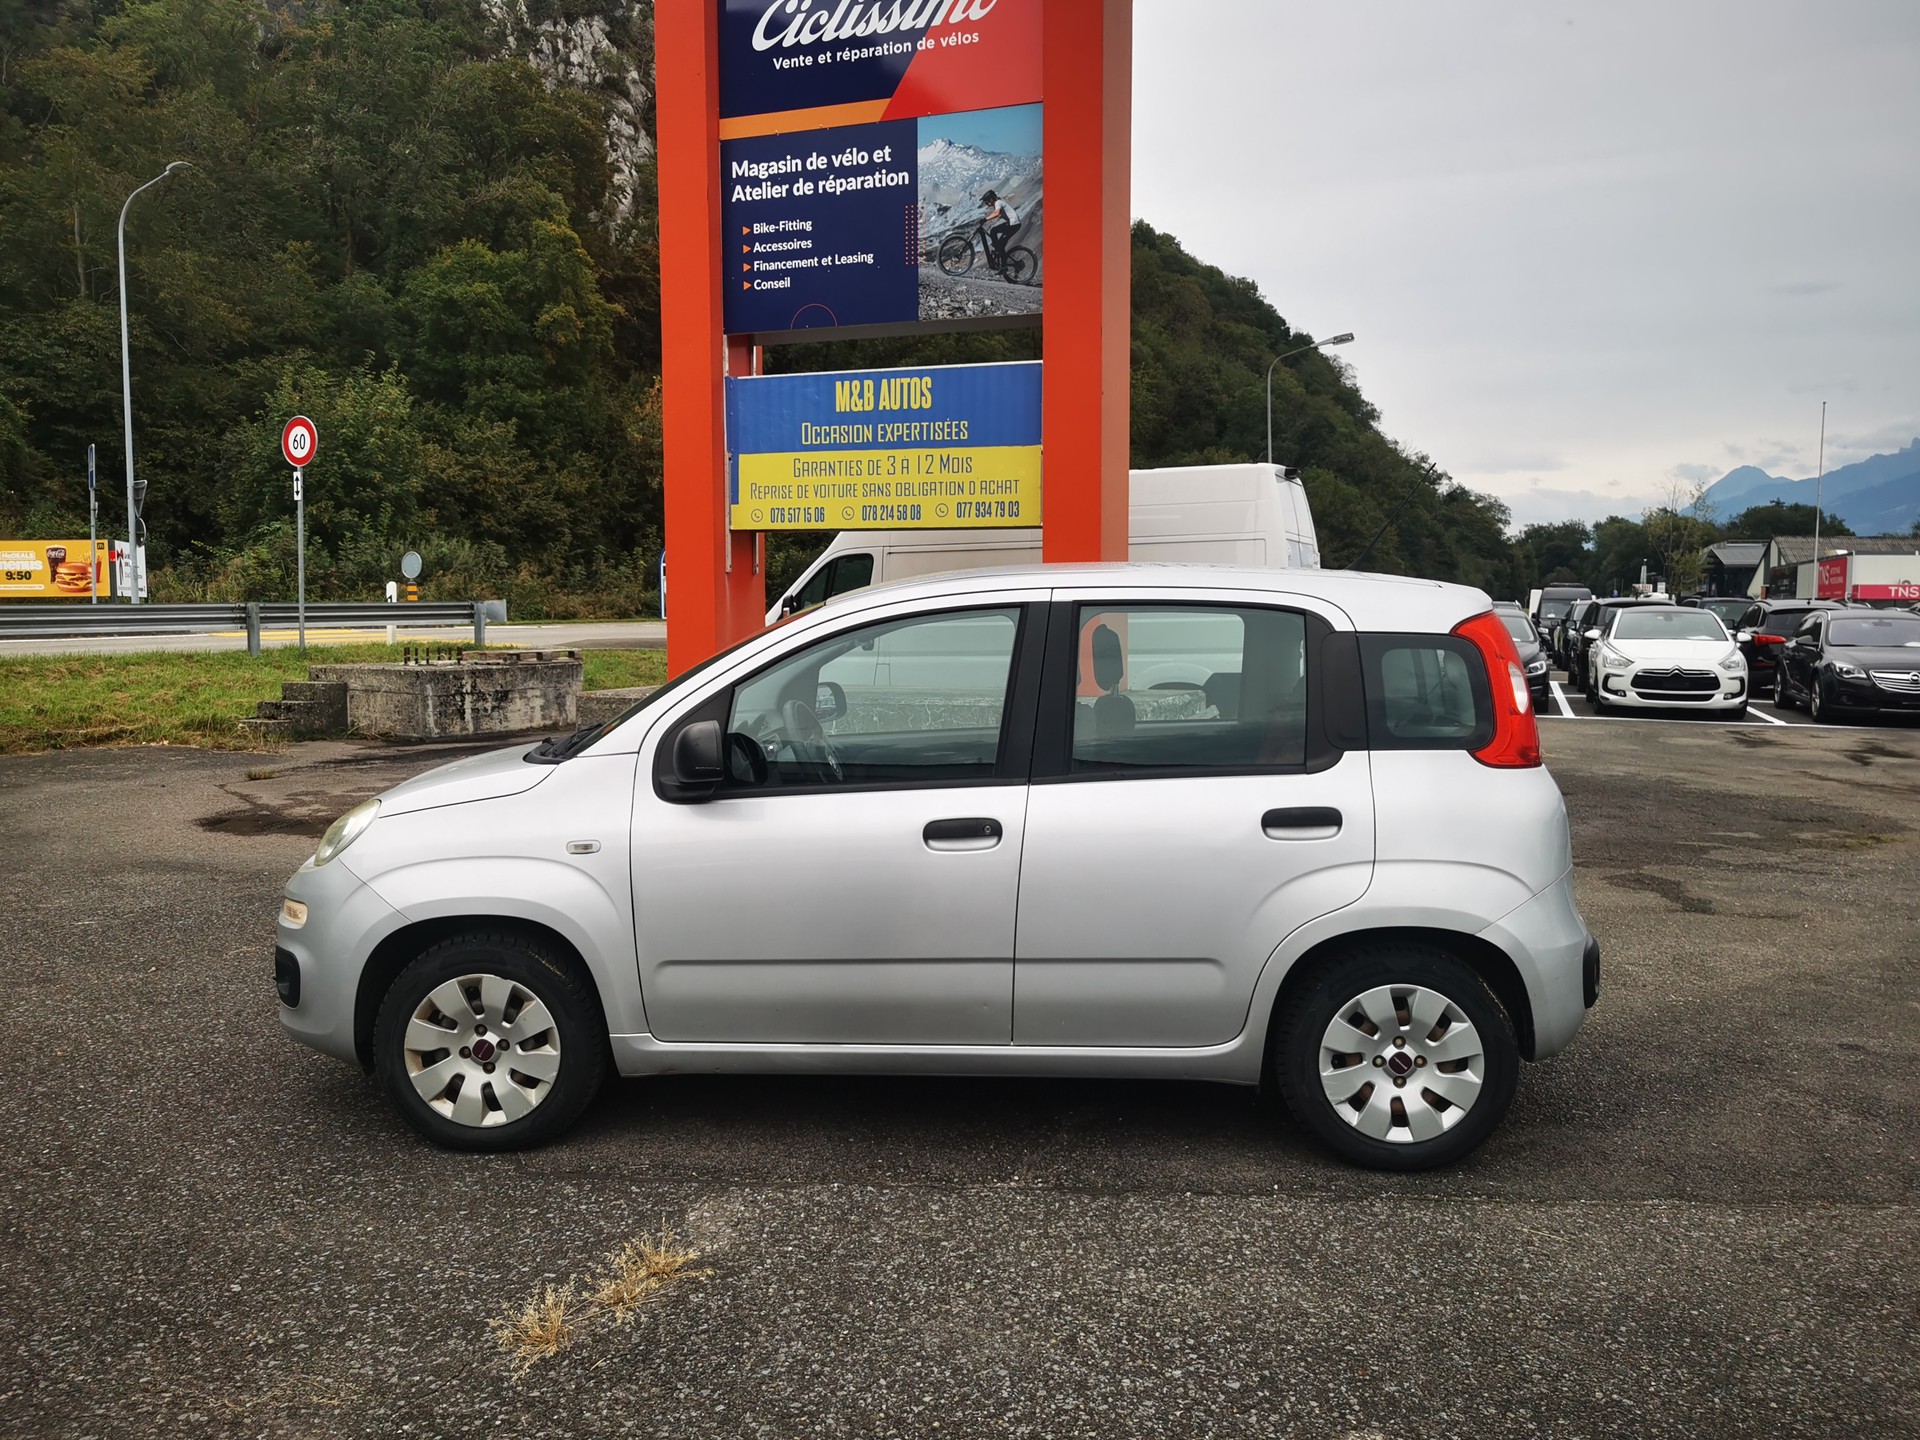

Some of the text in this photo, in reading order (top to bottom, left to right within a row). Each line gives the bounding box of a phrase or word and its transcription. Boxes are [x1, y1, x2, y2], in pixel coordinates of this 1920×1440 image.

[773, 30, 980, 70] Vente et réparation de vélos
[731, 145, 892, 179] Magasin de vélo et
[731, 169, 909, 203] Atelier de réparation
[753, 219, 812, 235] Bike-Fitting
[753, 238, 812, 253] Accessoires
[753, 252, 874, 272] Financement et Leasing
[753, 277, 791, 290] Conseil
[835, 376, 932, 413] M&B AUTOS
[292, 433, 306, 450] 60
[801, 422, 873, 445] OCCASION
[793, 458, 863, 478] GARANTIES
[867, 459, 882, 476] DE
[887, 455, 896, 476] 3
[939, 454, 973, 474] MOIS
[750, 482, 793, 500] REPRISE
[796, 484, 809, 499] DE
[813, 483, 858, 498] VOITURE
[862, 483, 891, 497] SANS
[895, 480, 964, 497] OBLIGATION
[770, 506, 825, 523] 076 517 15 06
[862, 504, 921, 521] 078 214 58 08
[956, 501, 1020, 518] 077 934 79 03
[1888, 586, 1920, 598] TNS
